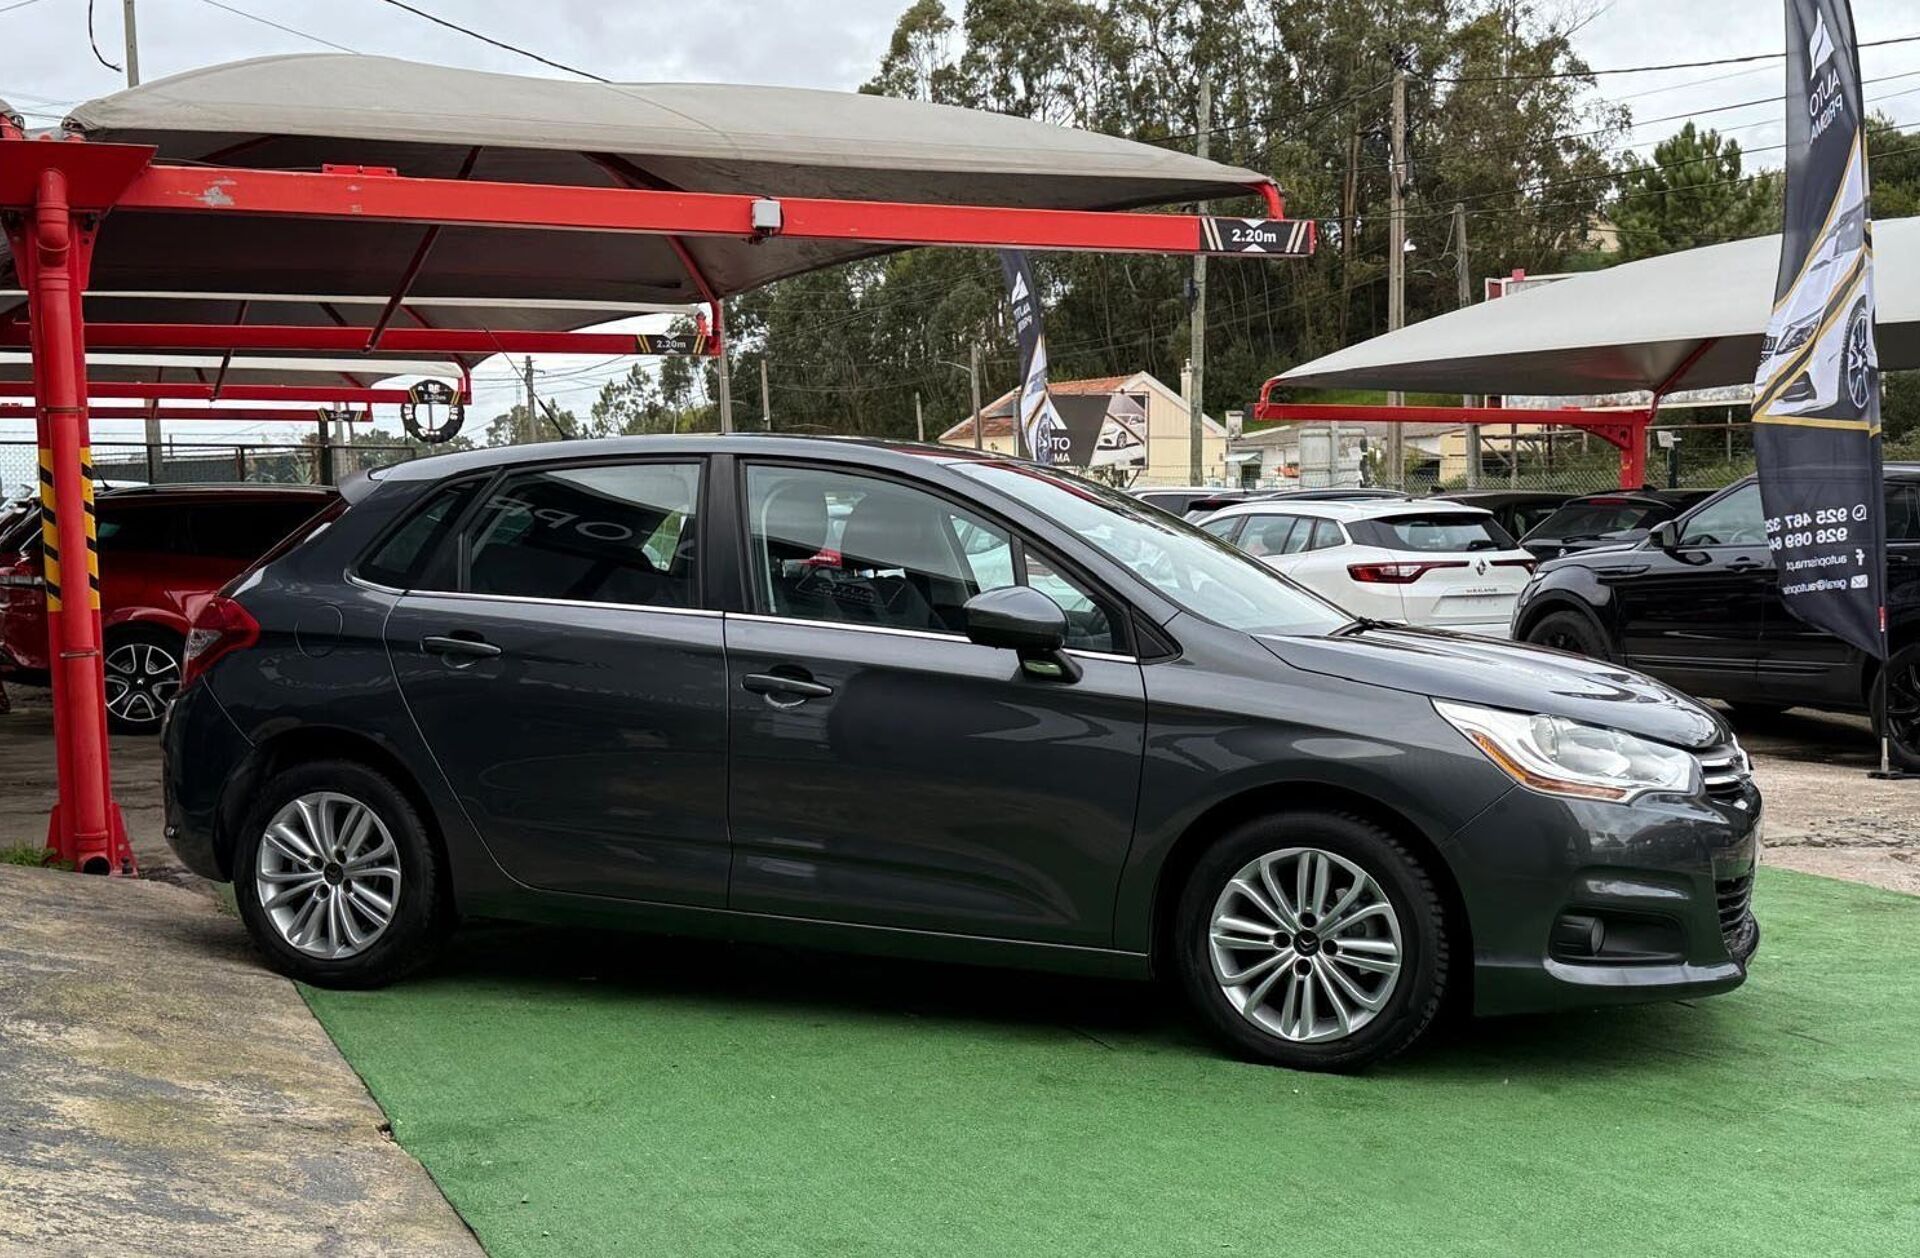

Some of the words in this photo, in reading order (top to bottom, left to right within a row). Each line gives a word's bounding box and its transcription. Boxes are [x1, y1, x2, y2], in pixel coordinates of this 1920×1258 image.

[1231, 228, 1277, 243] 2.20m
[656, 339, 686, 349] 2.20m
[1051, 437, 1071, 451] TO
[1052, 452, 1071, 463] MA
